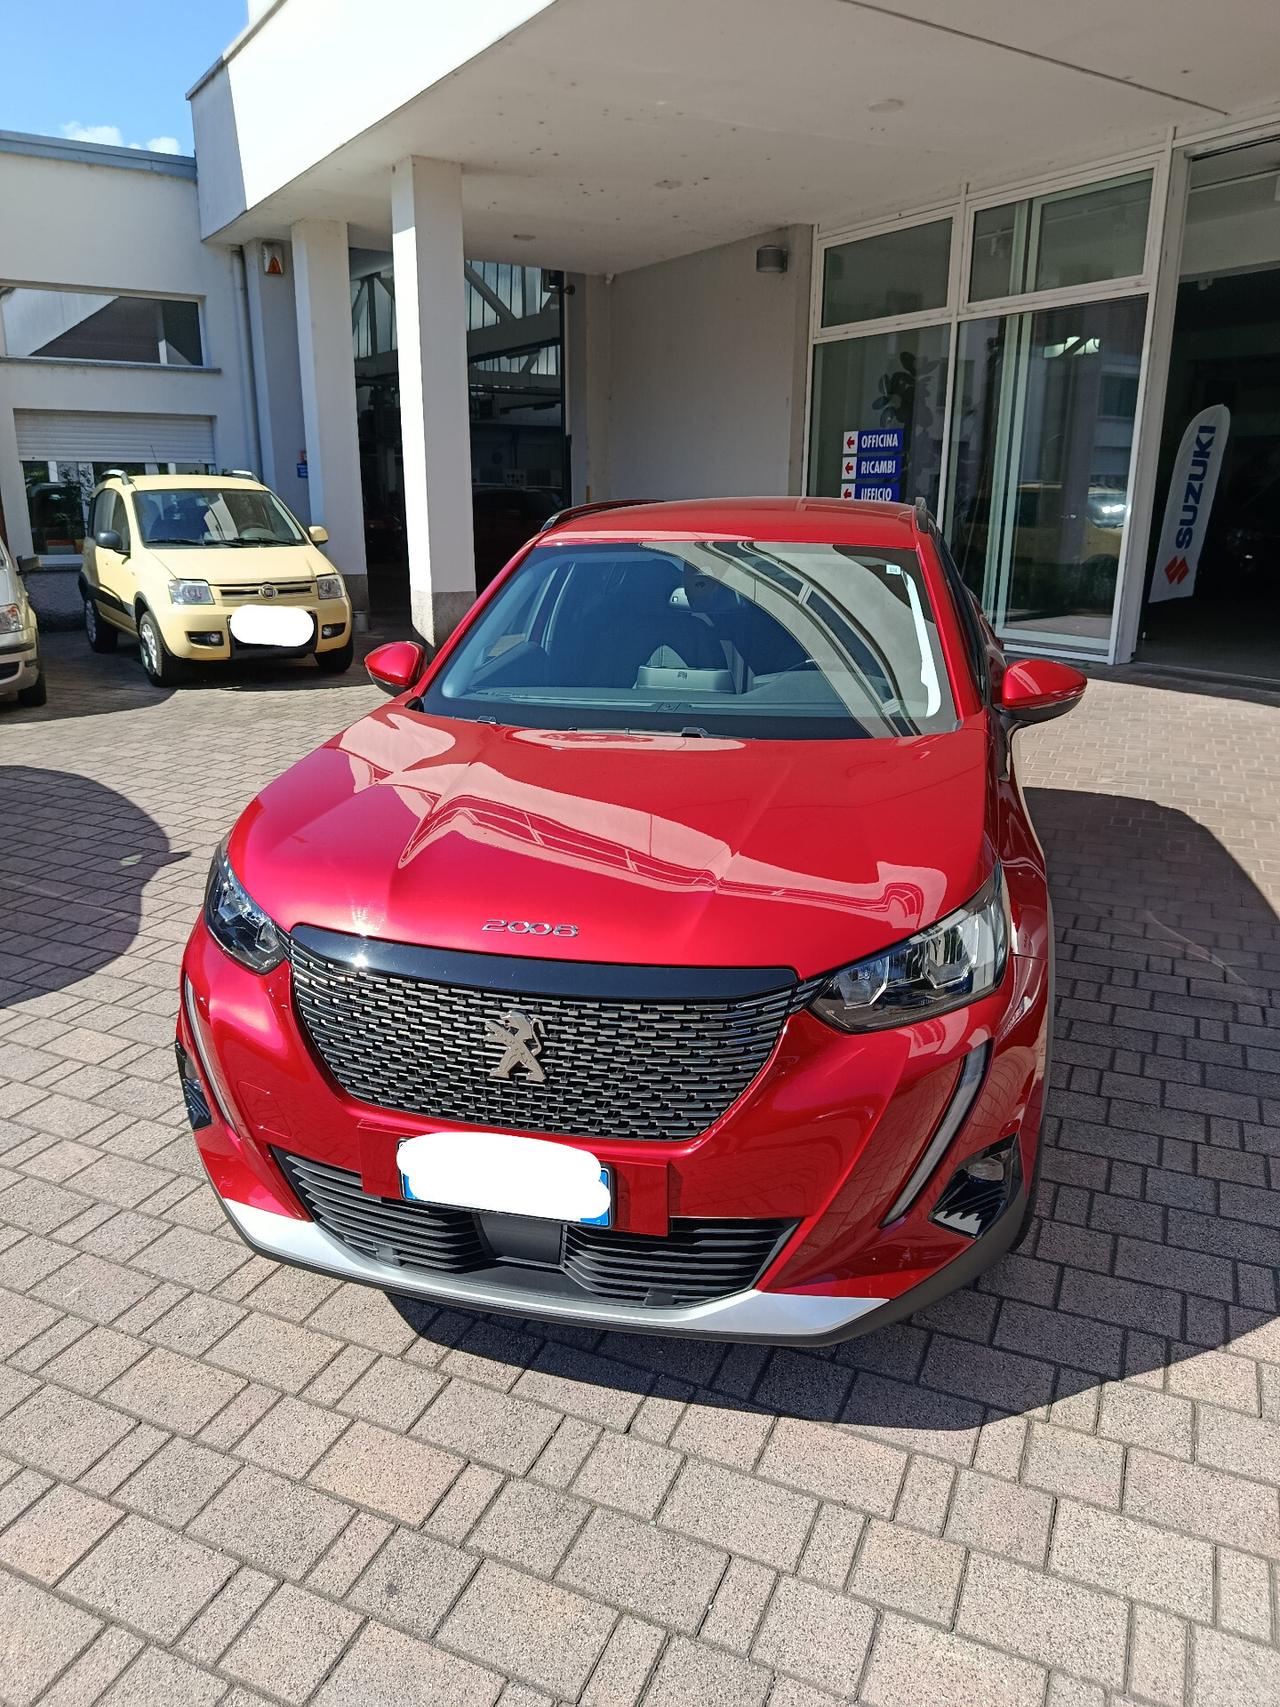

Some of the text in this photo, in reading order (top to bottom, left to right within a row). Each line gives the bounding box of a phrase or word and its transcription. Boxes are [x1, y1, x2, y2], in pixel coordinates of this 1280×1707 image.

[861, 433, 899, 449] OFFICINA
[860, 459, 897, 474] RICAMBI
[860, 487, 893, 501] UFFICIO
[1175, 425, 1217, 550] SUZUKI
[481, 918, 579, 937] 2008
